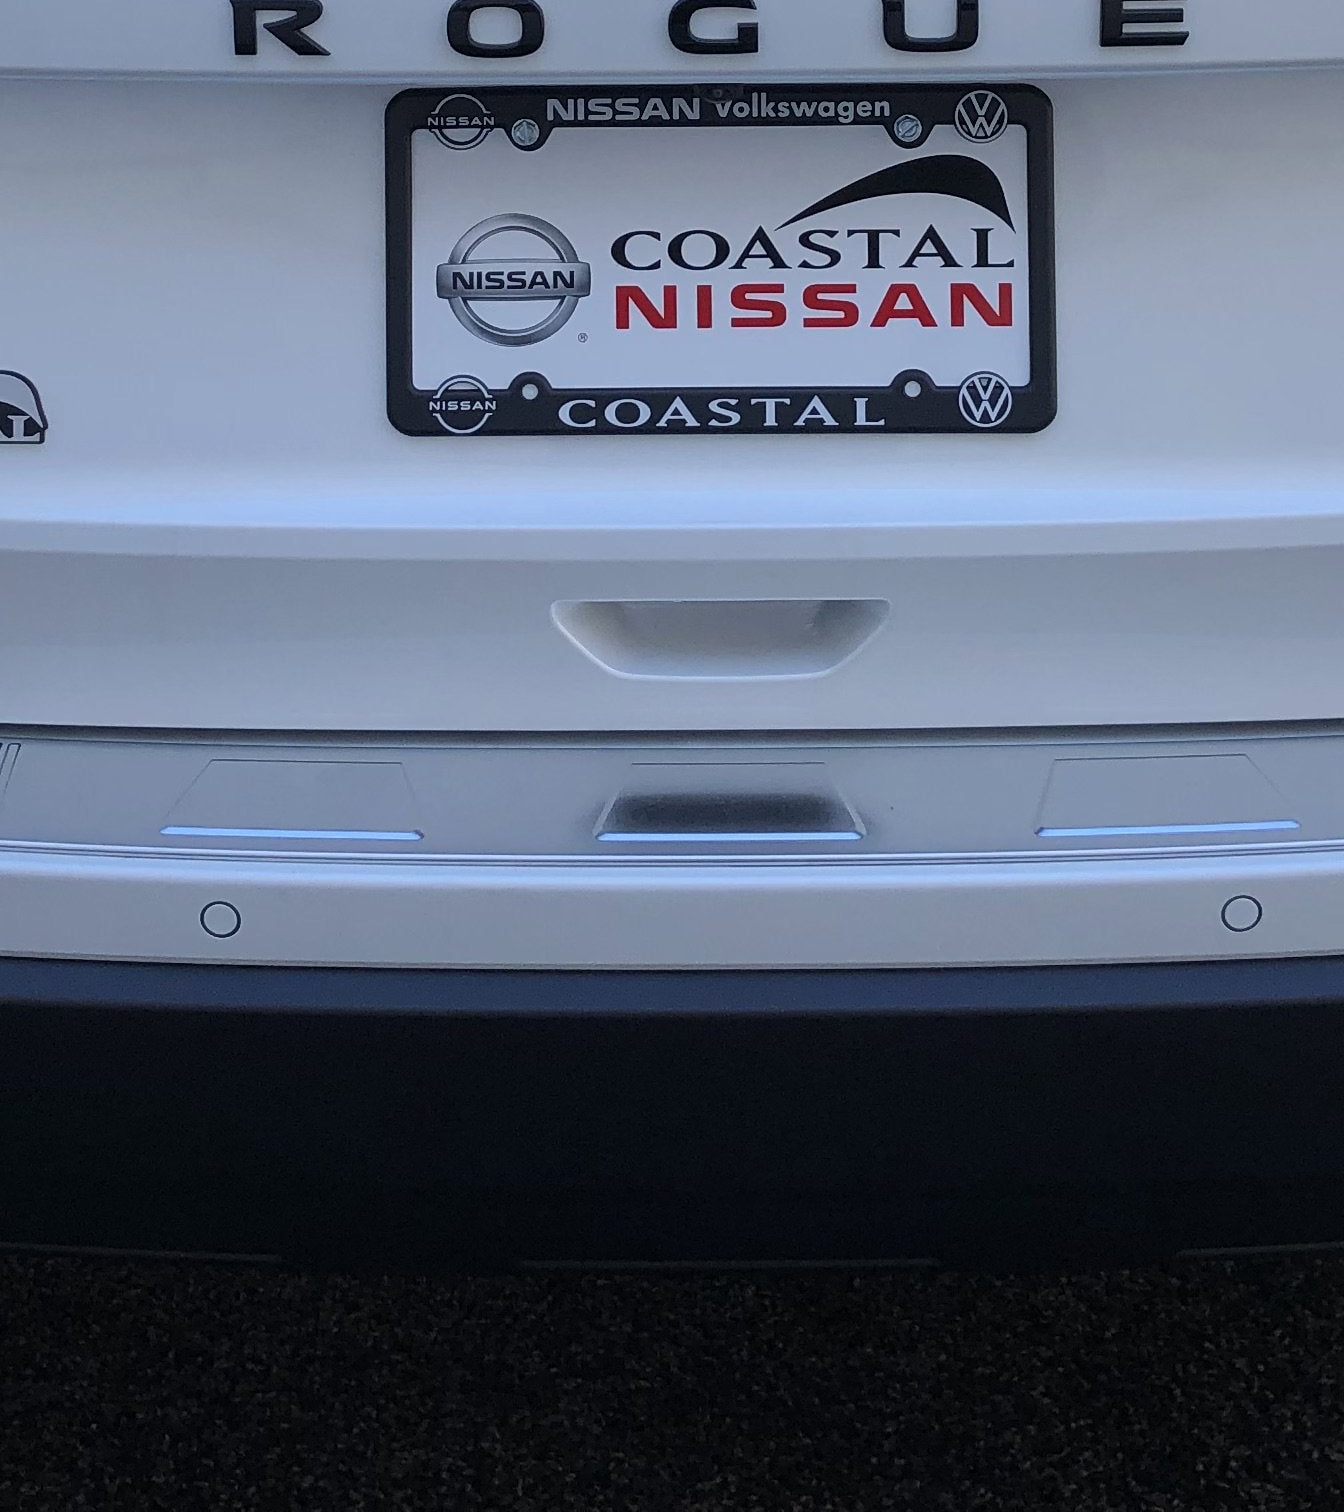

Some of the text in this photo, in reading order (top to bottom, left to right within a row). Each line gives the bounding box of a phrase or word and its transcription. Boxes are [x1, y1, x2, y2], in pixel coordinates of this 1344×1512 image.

[546, 97, 701, 121] NISSAN
[427, 116, 495, 127] NISSAN
[610, 224, 1016, 271] COASTAL
[451, 270, 575, 290] NISSAN
[614, 282, 1013, 330] NISSAN
[429, 399, 497, 411] NISSAN
[558, 394, 886, 428] COASTAL
